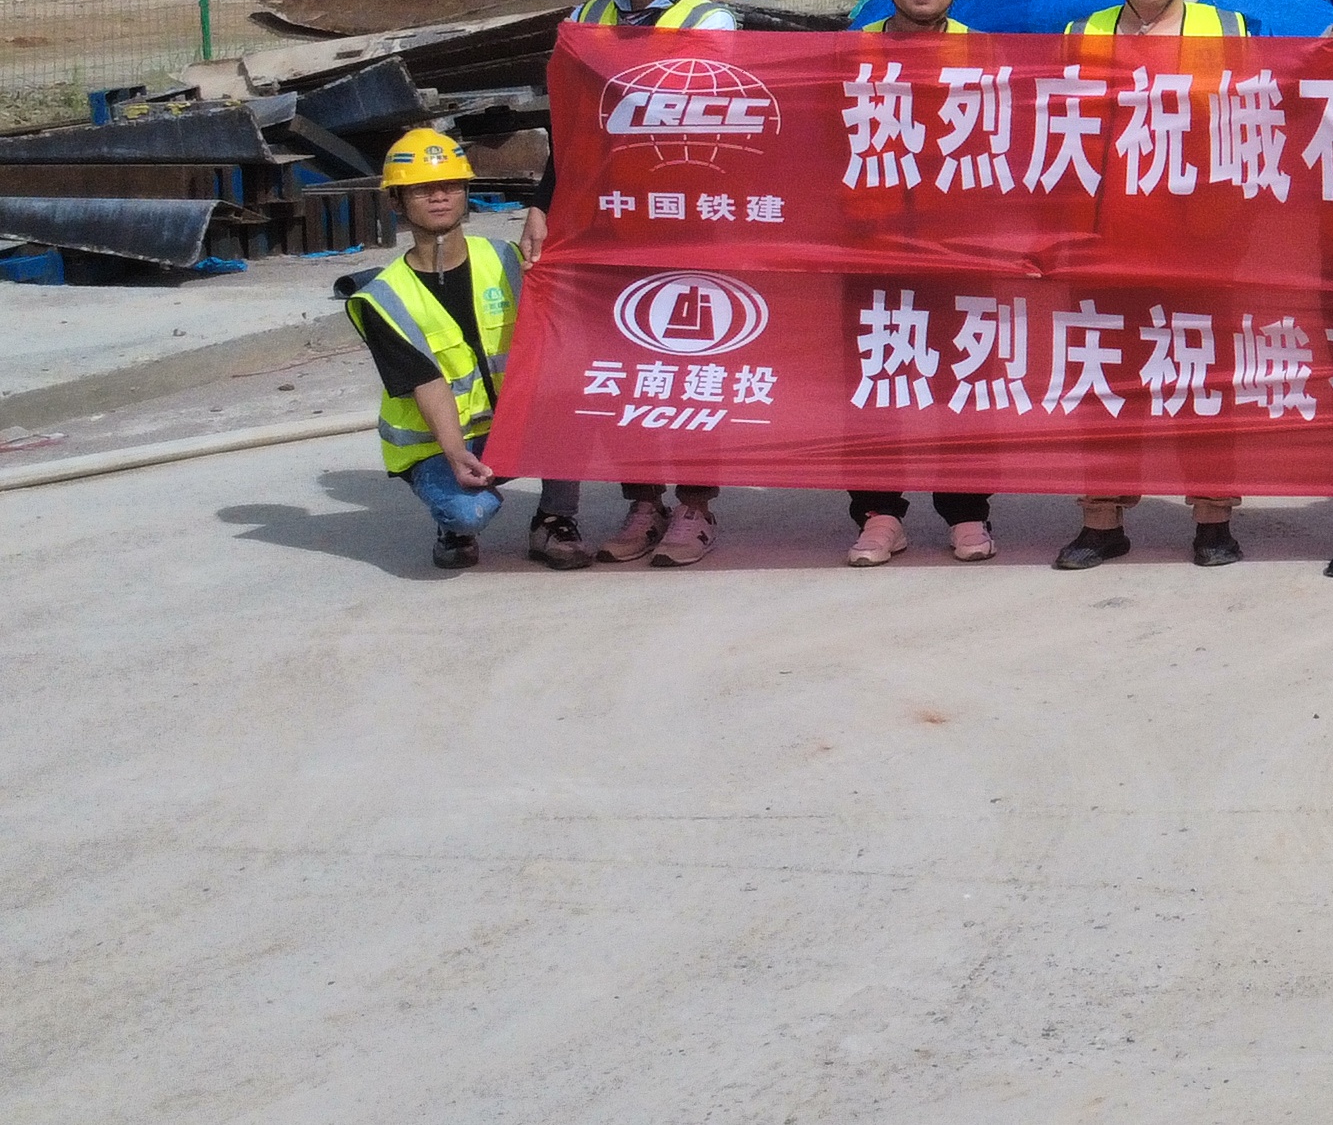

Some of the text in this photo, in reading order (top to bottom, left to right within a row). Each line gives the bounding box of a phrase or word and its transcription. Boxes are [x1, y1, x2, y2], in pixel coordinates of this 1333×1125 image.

[606, 90, 771, 135] CRCC
[599, 191, 785, 223] 中国铁建
[583, 360, 778, 406] 云南建投
[617, 405, 728, 432] YCIH
